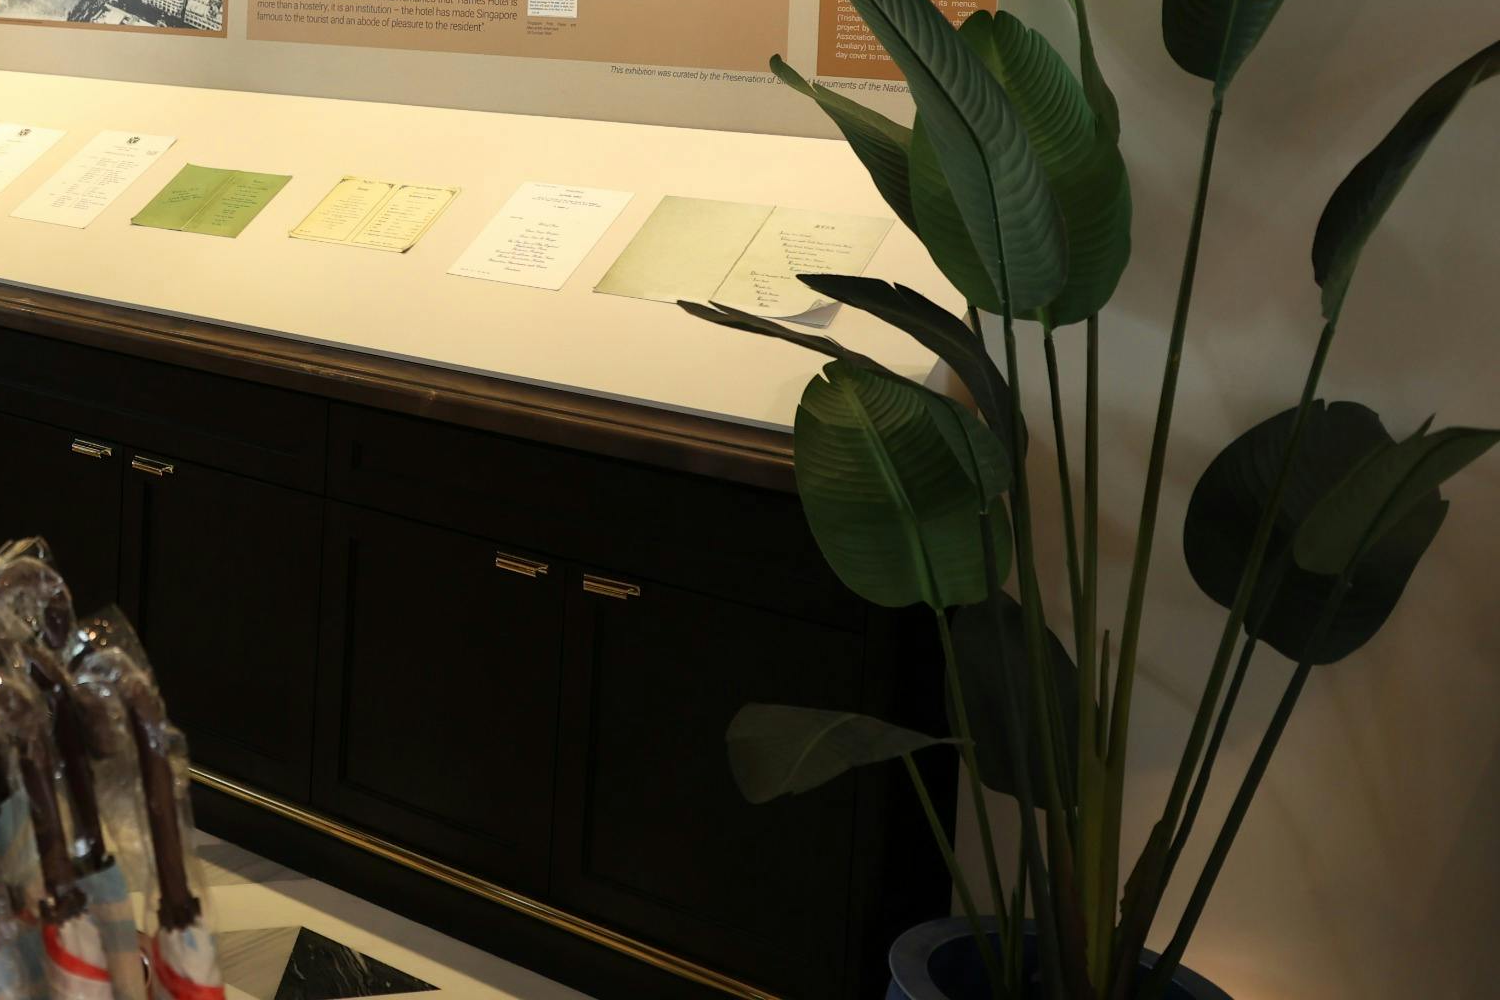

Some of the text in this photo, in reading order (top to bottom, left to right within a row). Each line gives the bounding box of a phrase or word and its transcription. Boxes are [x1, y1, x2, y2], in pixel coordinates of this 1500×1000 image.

[611, 66, 623, 74] This
[672, 71, 698, 79] curated
[722, 73, 767, 83] Preservation
[859, 81, 868, 90] of
[869, 81, 881, 90] the
